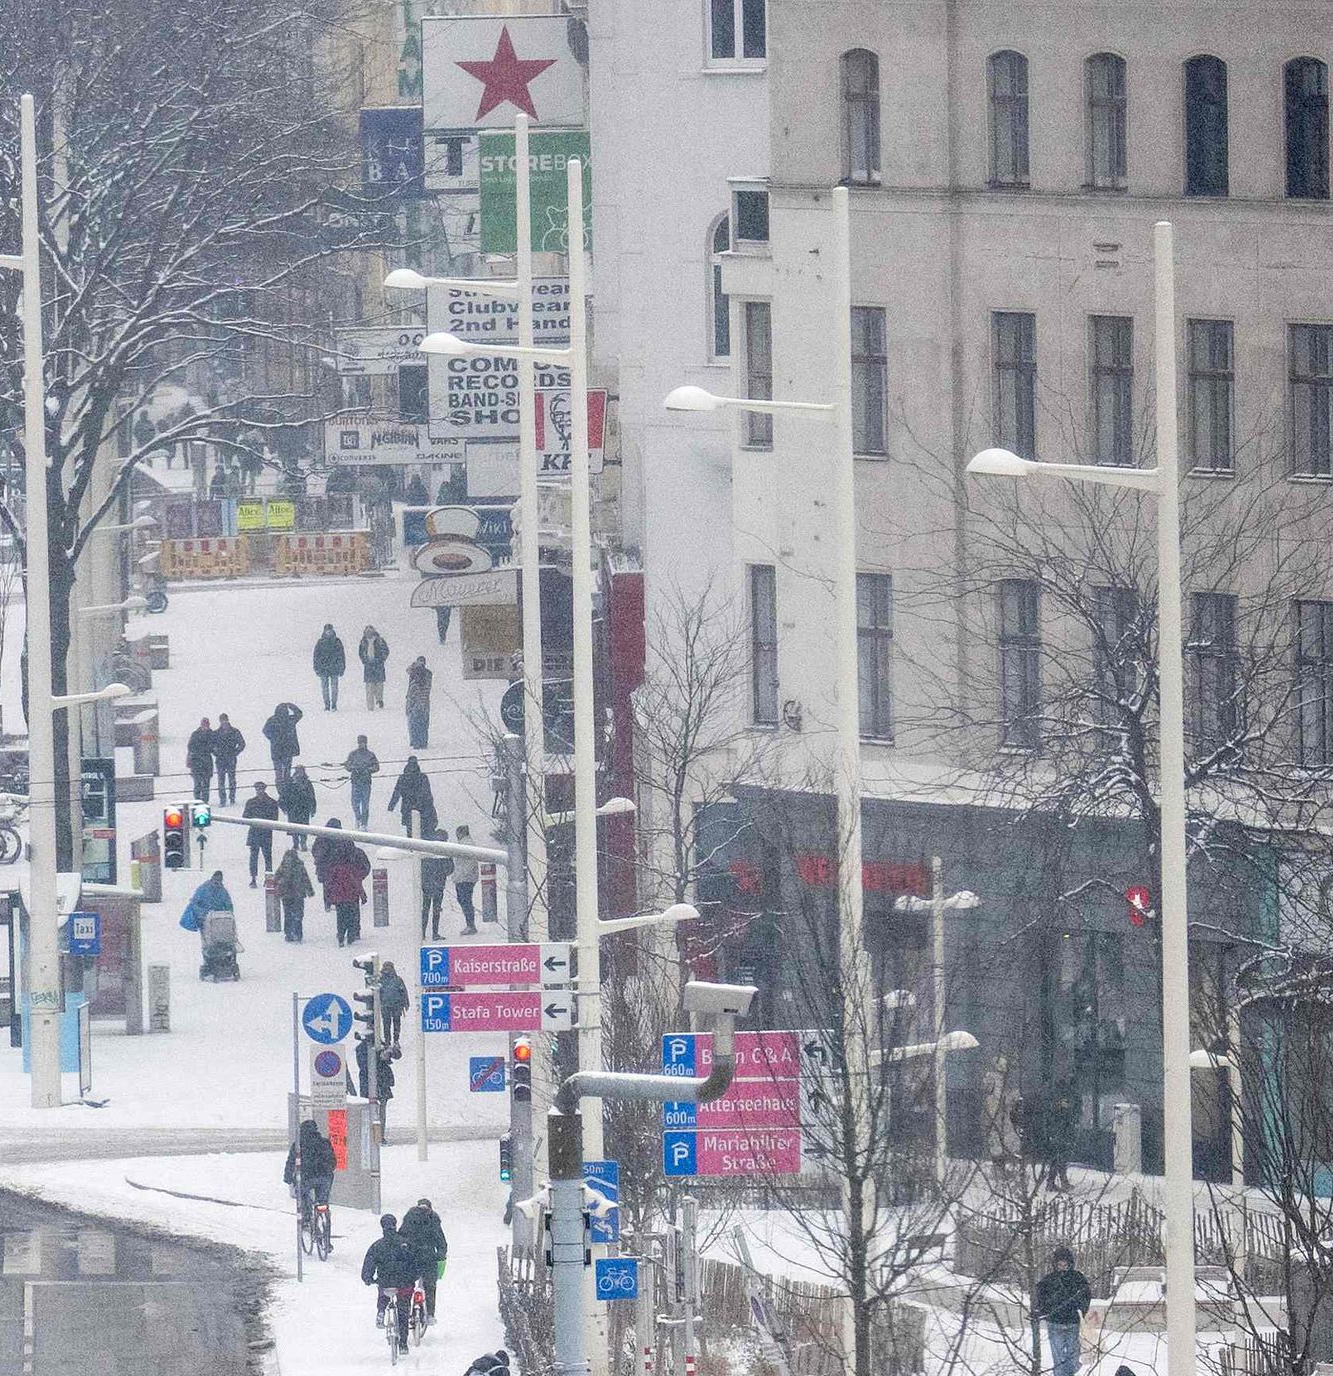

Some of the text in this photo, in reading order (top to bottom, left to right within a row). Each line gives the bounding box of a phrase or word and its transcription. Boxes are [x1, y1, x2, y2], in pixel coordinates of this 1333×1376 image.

[449, 318, 496, 332] 2nd
[448, 373, 571, 390] RECODS
[540, 454, 593, 471] KF
[76, 922, 93, 934] Taxi
[454, 959, 537, 973] Kaiserstraße
[428, 997, 443, 1017] P
[453, 1006, 539, 1019] Stafa Tower
[671, 1043, 686, 1062] P
[674, 1147, 689, 1166] P
